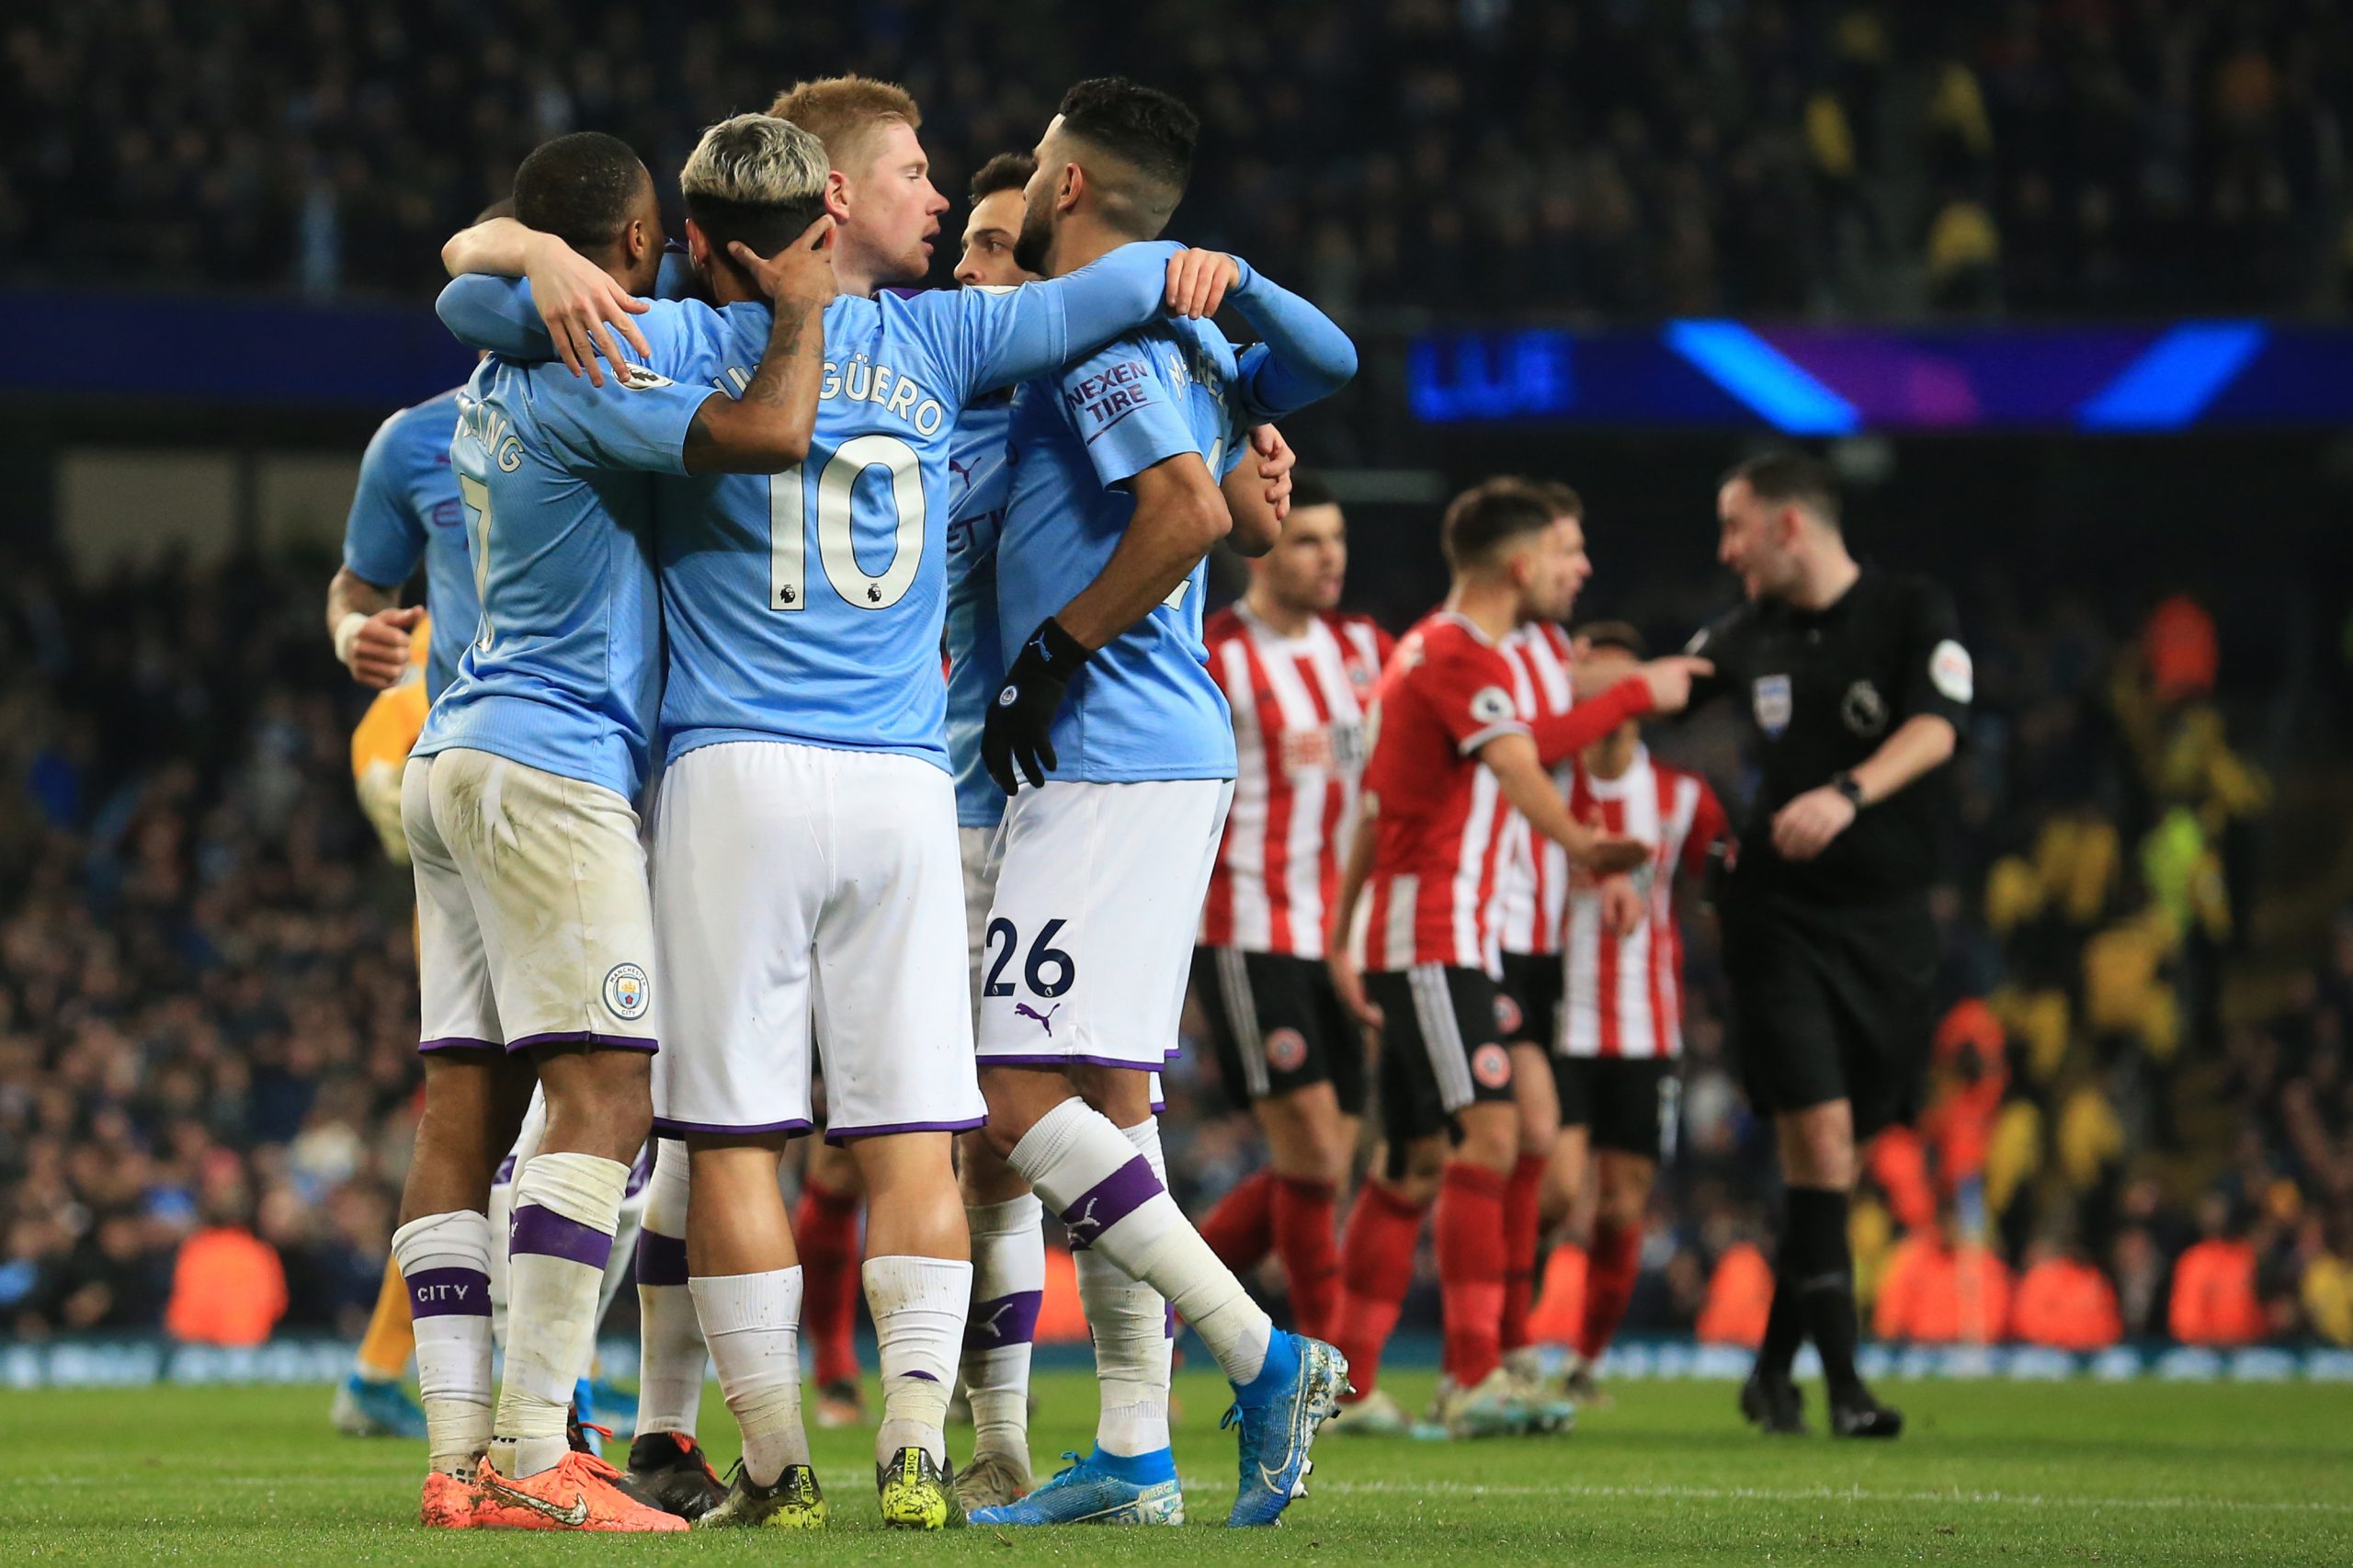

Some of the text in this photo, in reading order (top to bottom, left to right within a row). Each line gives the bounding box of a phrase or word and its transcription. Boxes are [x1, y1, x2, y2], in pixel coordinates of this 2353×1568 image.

[820, 353, 942, 436] GÜERO
[1066, 360, 1148, 411] NEXEN
[1086, 383, 1147, 423] TIRE
[769, 434, 926, 610] 10
[947, 506, 1006, 553] ETI
[460, 472, 493, 653] 7
[609, 967, 646, 986] MANCHESTER
[983, 917, 1075, 998] 26
[417, 1284, 469, 1301] CITY
[906, 1454, 917, 1476] ONE
